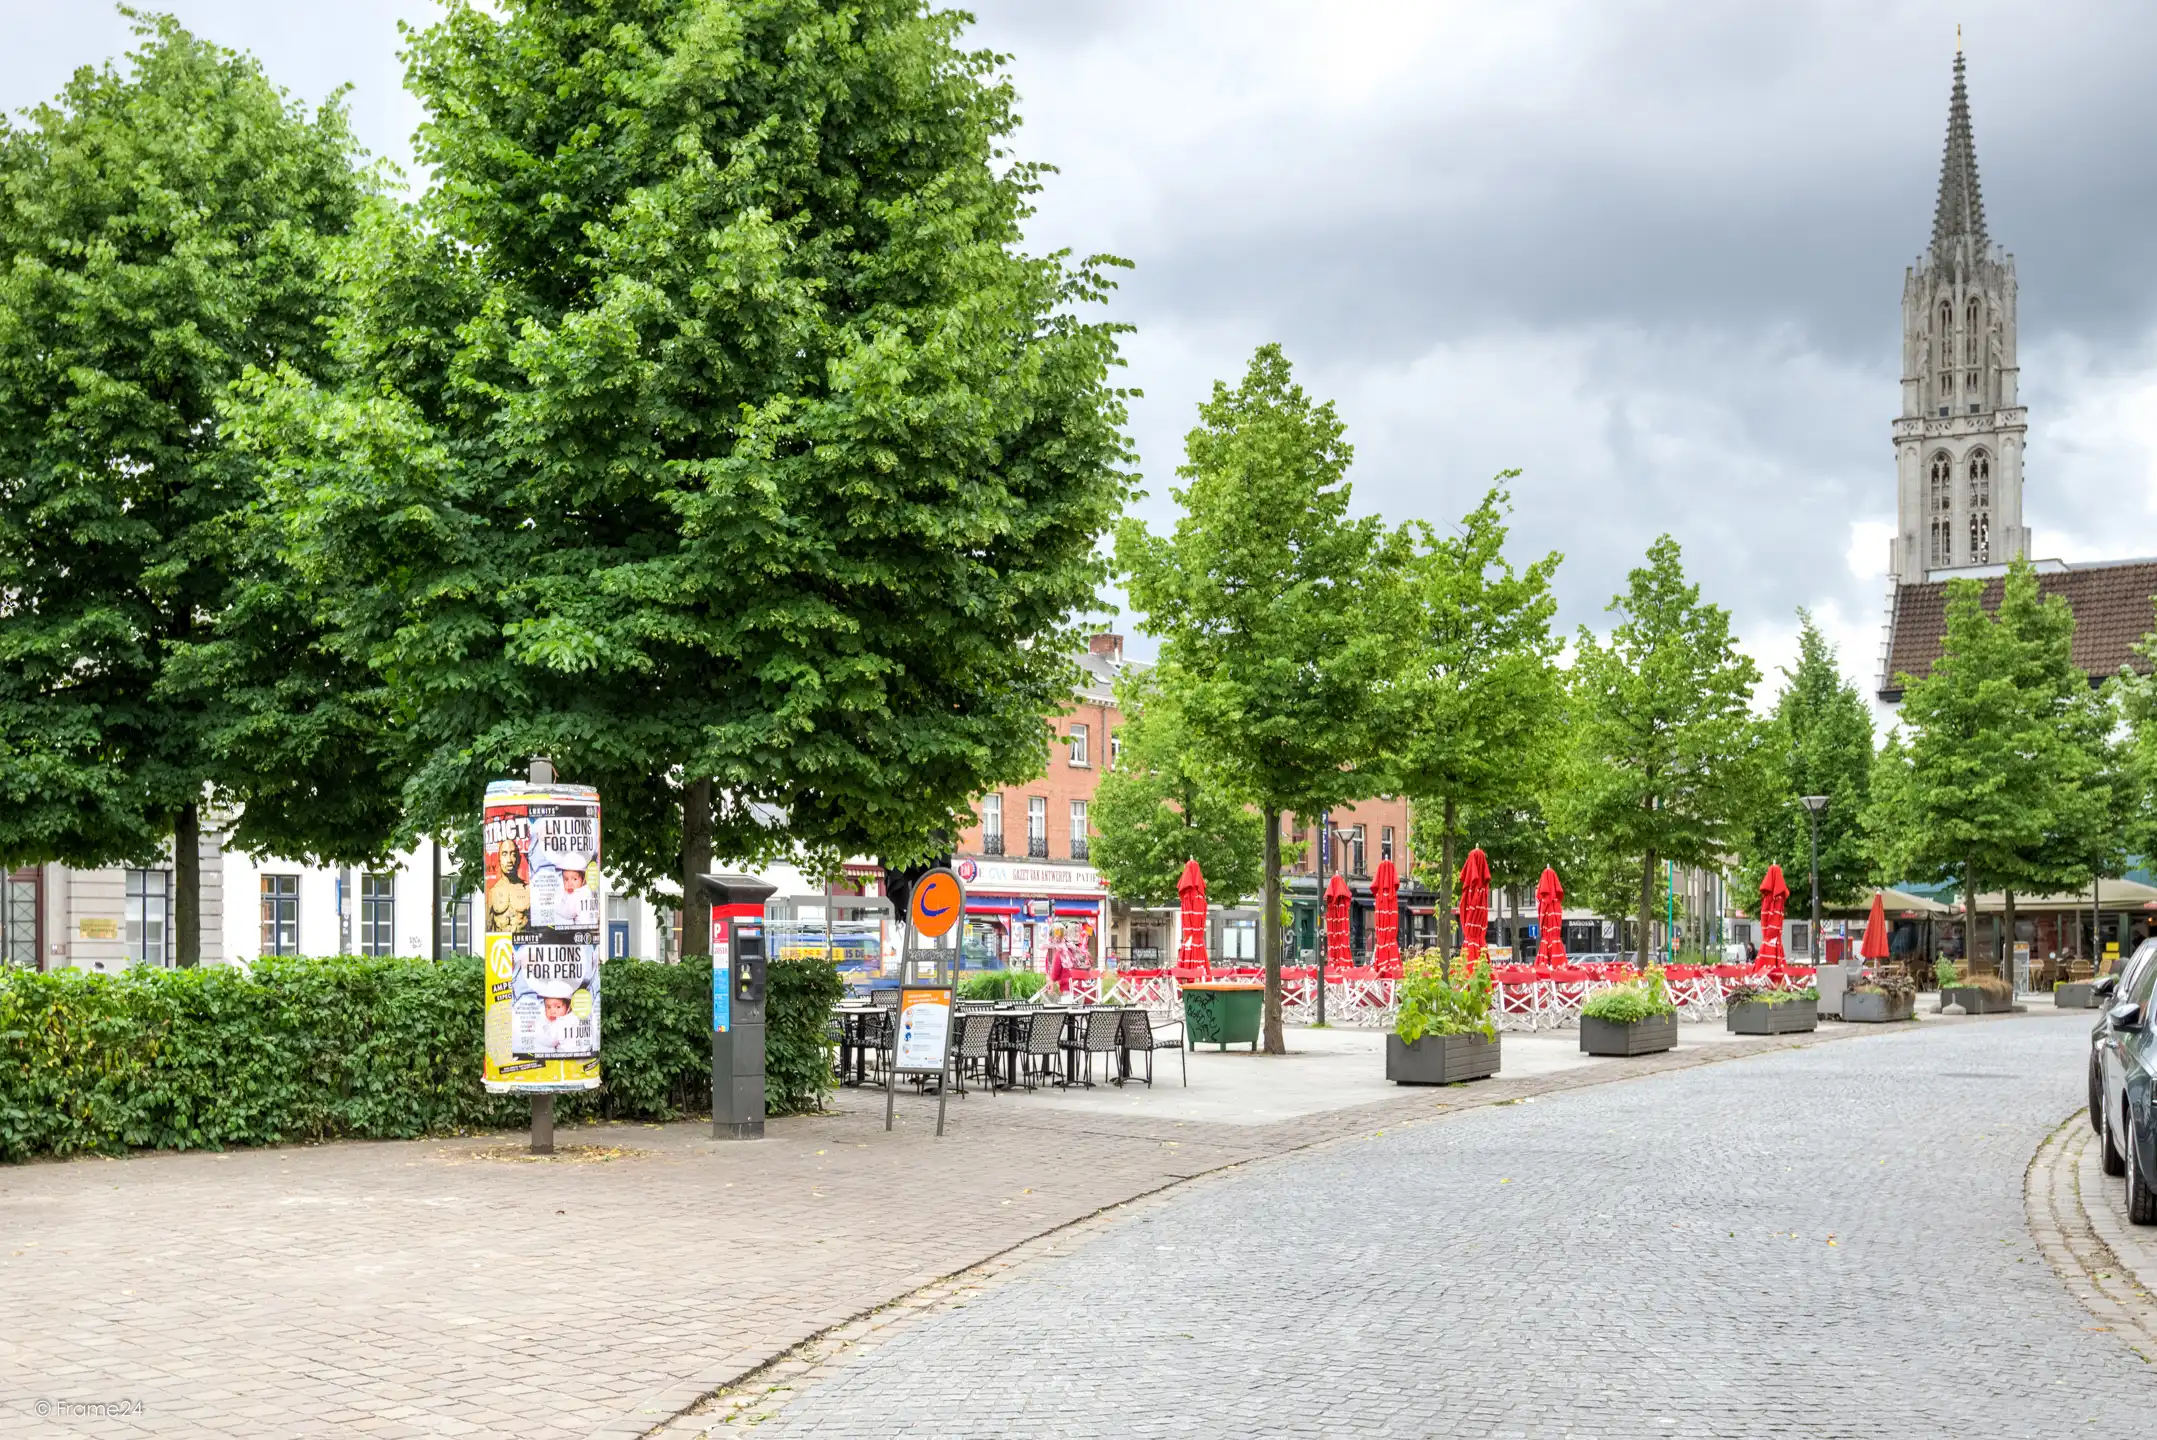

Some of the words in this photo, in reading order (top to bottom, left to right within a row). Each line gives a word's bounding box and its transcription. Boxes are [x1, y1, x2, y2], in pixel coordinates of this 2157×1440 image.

[545, 819, 561, 835] LN
[564, 819, 593, 835] LIONS
[543, 836, 567, 851] FOR
[570, 836, 594, 851] PERU
[1030, 868, 1040, 881] VAN
[1041, 869, 1072, 883] ANTWERPEN
[713, 922, 722, 939] P
[528, 947, 544, 962] LN
[549, 947, 581, 962] LIONS
[526, 964, 550, 979] FOR
[553, 964, 583, 979] PERU
[563, 1027, 573, 1039] 11
[575, 1026, 591, 1039] JUNI
